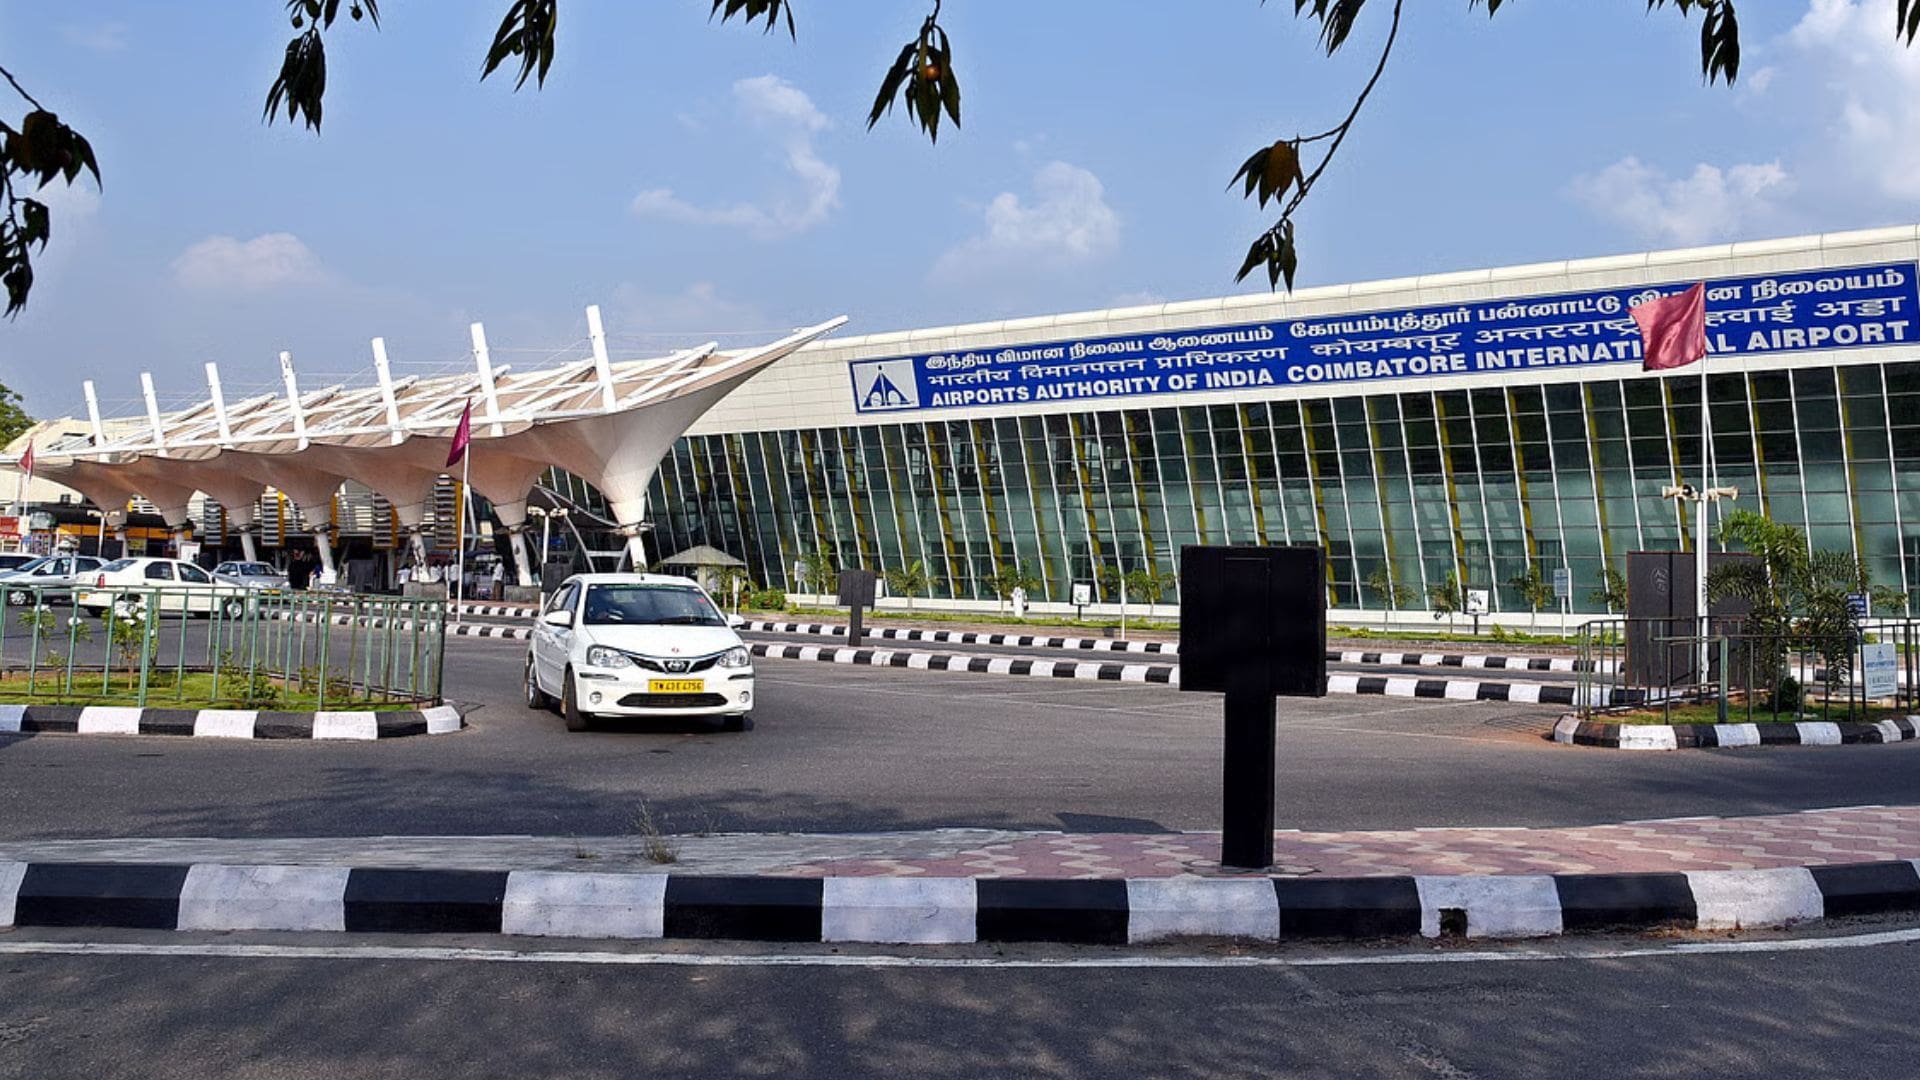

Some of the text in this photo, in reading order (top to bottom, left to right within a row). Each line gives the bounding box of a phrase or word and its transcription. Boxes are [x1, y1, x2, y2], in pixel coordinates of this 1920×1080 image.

[926, 353, 991, 371] இந்திய
[996, 348, 1065, 364] விமான
[1070, 341, 1144, 361] நிலைய
[1149, 326, 1274, 351] ஆணையம்
[1289, 308, 1472, 337] கோயம்புத்தூர்
[1478, 295, 1621, 320] பன்னாட்டு
[1751, 269, 1905, 303] நிலையம்
[928, 368, 1012, 386] भारतीय
[1019, 359, 1147, 380] विमानपत्तन
[1155, 347, 1289, 369] प्राधिकरण
[1704, 300, 1797, 326] हवाई
[931, 385, 1030, 407] AIRPORTS
[1036, 376, 1161, 400] AUTHORITY
[1168, 373, 1198, 390] OF
[1205, 368, 1275, 388] INDIA
[1288, 353, 1468, 383] COIMBATORE
[1746, 320, 1910, 350] AIRPORT
